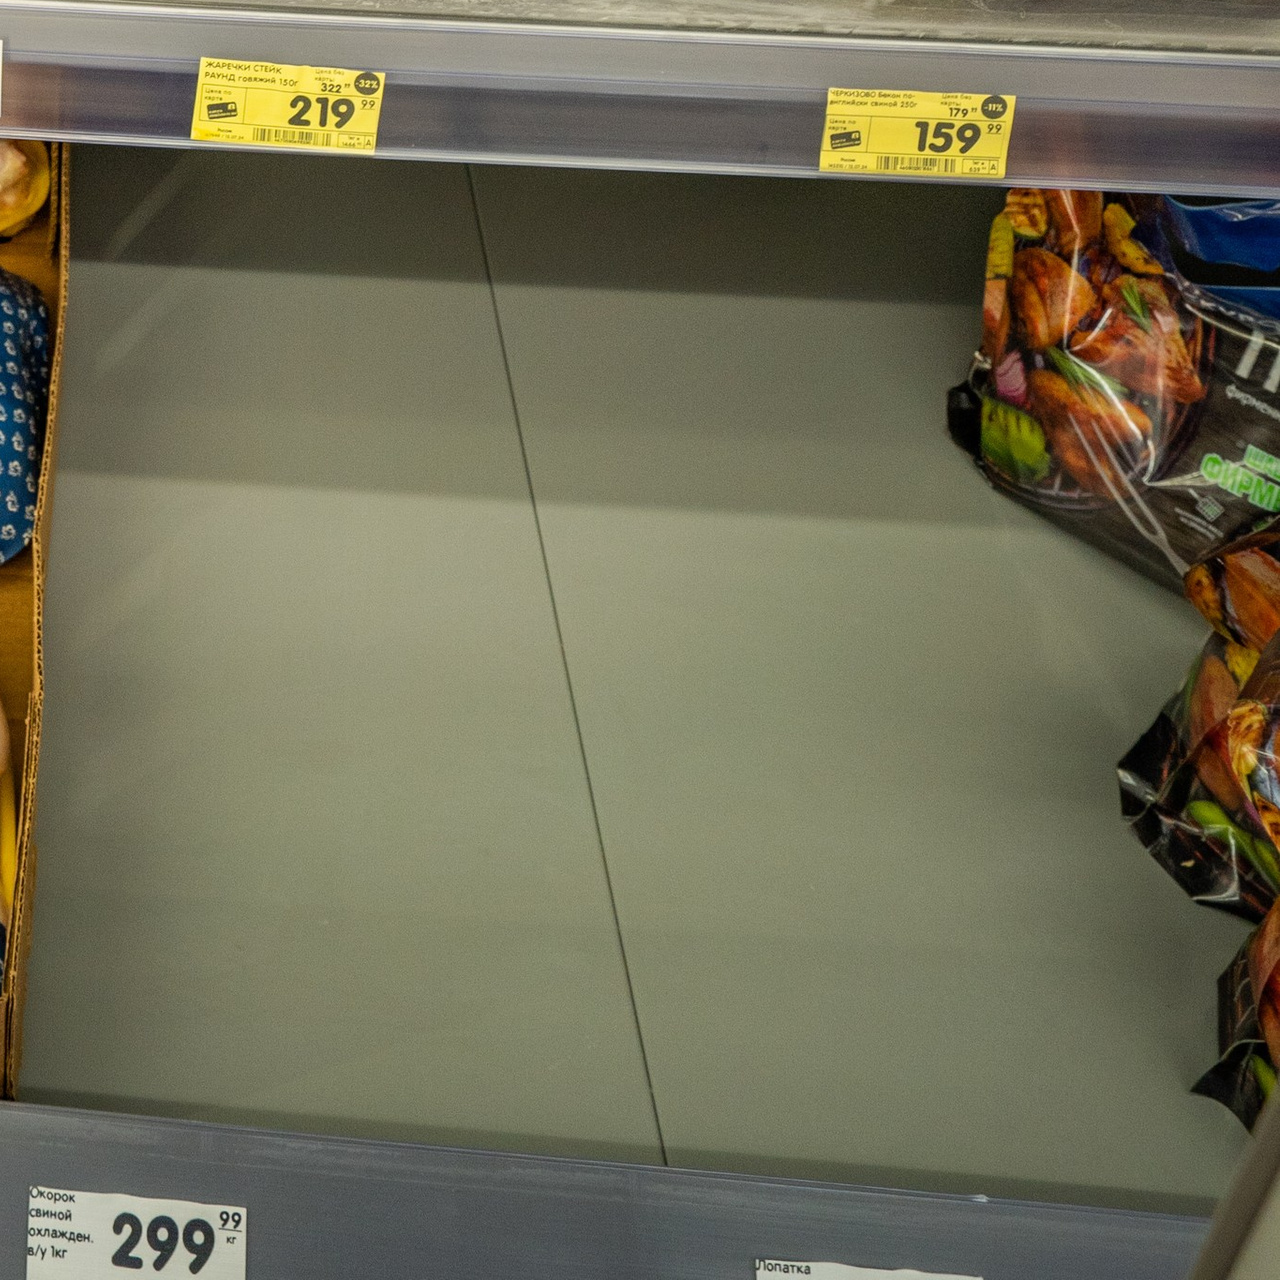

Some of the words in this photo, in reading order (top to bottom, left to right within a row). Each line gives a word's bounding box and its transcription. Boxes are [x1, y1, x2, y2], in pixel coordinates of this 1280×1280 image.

[205, 61, 250, 72] ЖАРЕЧКИ
[254, 64, 282, 74] СТЕЙК
[205, 72, 235, 82] РАУНД
[238, 76, 277, 85] говяжий
[279, 78, 298, 87] 150г
[321, 83, 341, 93] 322
[830, 90, 876, 99] ЧЕРКИЗОВО
[288, 95, 355, 129] 219
[361, 100, 375, 110] 99
[949, 107, 968, 117] 179
[915, 121, 981, 154] 159
[988, 124, 1002, 134] 99
[30, 1187, 75, 1203] Окорок
[29, 1208, 72, 1222] свиной
[112, 1212, 215, 1275] 299
[219, 1211, 242, 1229] 99
[226, 1236, 236, 1244] кг
[51, 1246, 67, 1259] 1кг
[755, 1259, 812, 1276] Лопатка
